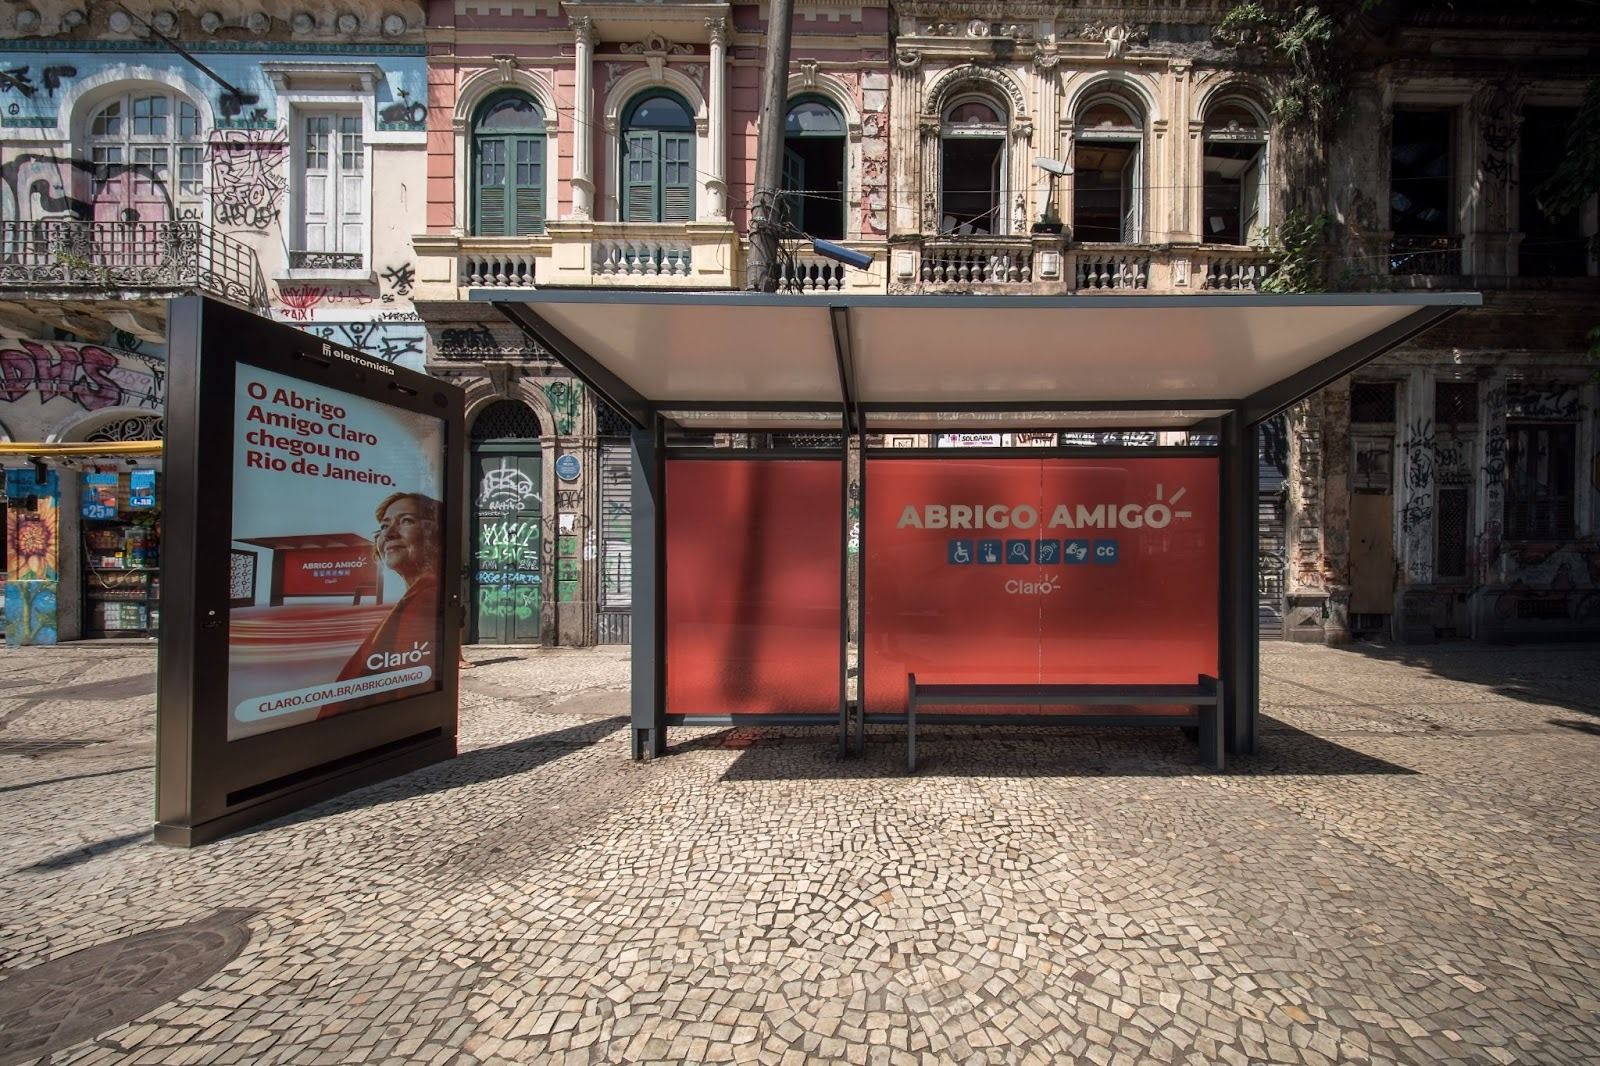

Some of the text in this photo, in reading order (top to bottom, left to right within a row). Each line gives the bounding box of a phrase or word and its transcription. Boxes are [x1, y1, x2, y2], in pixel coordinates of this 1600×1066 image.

[332, 349, 396, 376] eletromidia
[247, 382, 347, 421] O Abrigo
[246, 405, 378, 446] Amigo Claro
[246, 429, 361, 462] chegou no
[246, 450, 397, 487] Rio de Janeiro.
[896, 503, 1172, 529] ABRIGO AMIGO
[302, 559, 364, 570] ABRIGO AMIGO
[1004, 578, 1053, 595] Claro
[366, 645, 424, 671] Claro
[258, 670, 424, 714] CLARO.COM.BR/ABRIGOAMIGO
